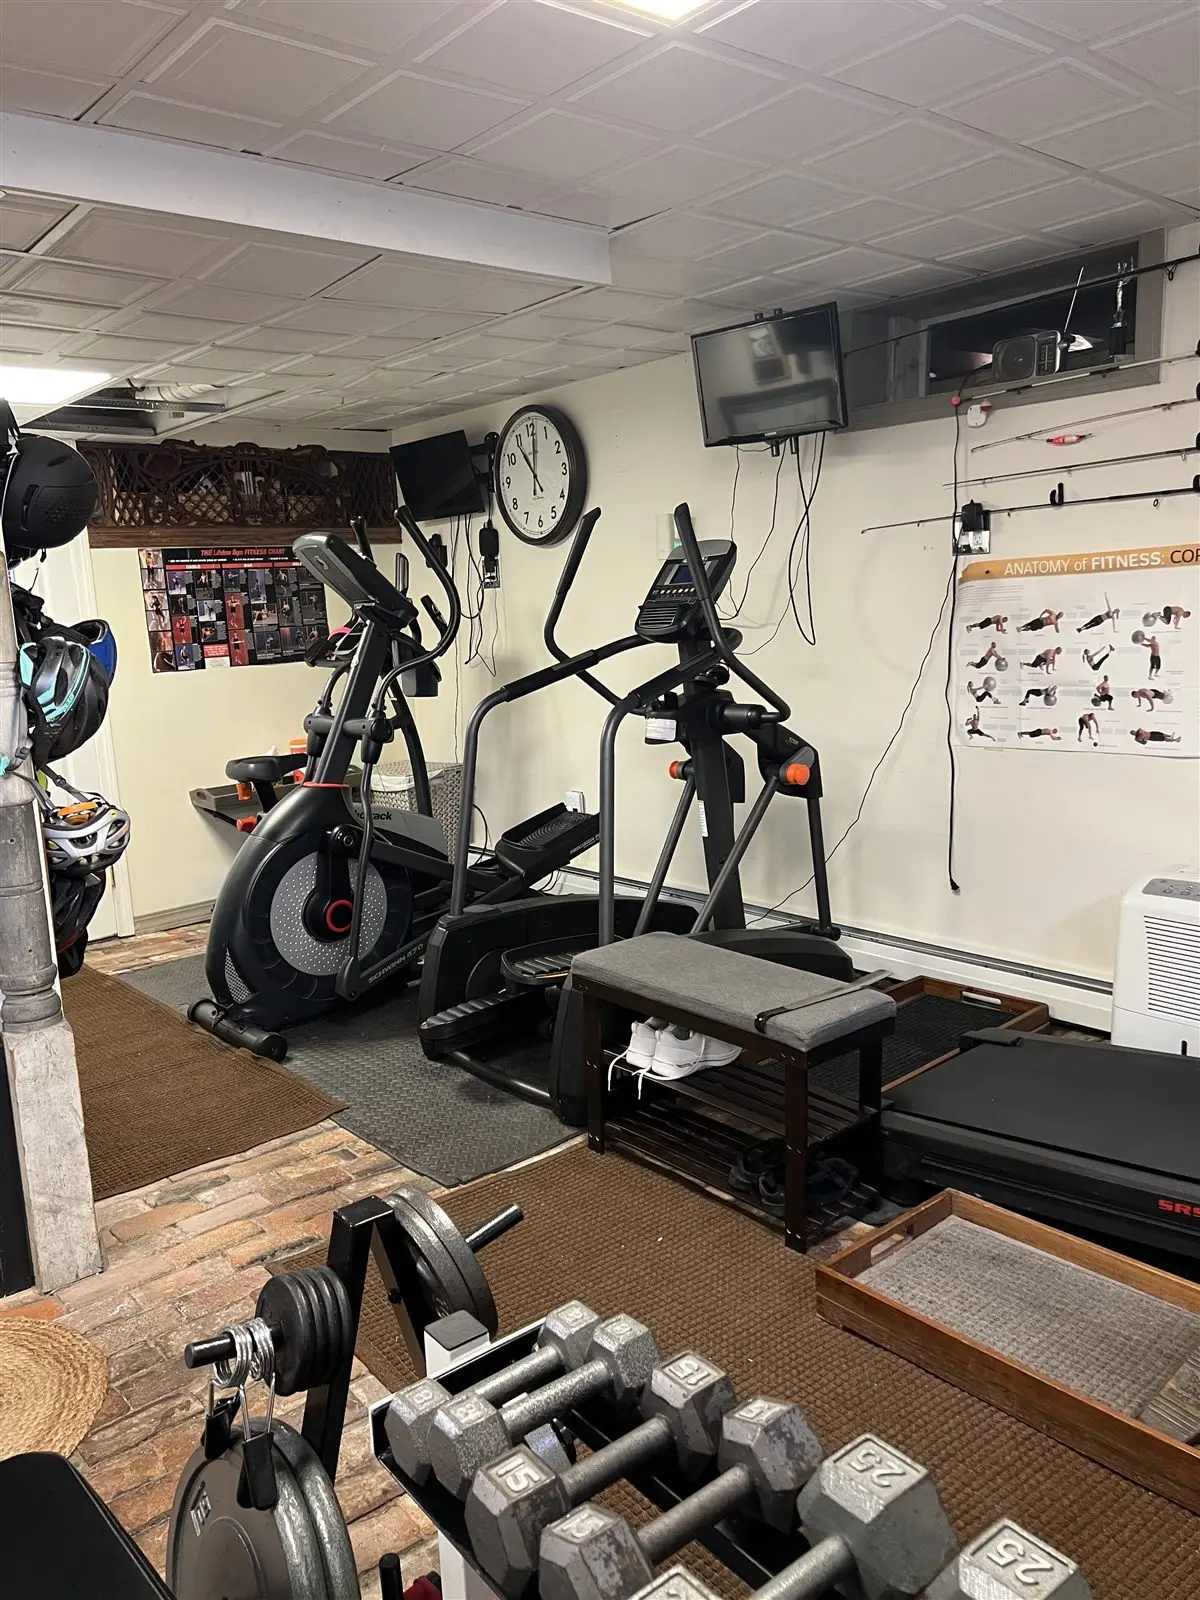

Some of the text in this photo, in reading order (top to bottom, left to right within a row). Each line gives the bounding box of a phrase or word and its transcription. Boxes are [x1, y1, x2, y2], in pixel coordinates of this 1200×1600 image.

[526, 422, 536, 437] 12
[515, 434, 522, 447] 11
[554, 440, 561, 454] 2
[507, 453, 516, 466] 10
[561, 462, 568, 476] 3
[505, 476, 511, 489] 9
[559, 488, 565, 500] 4
[512, 498, 519, 510] 8
[523, 512, 530, 524] 7
[550, 506, 557, 519] 5
[537, 515, 544, 528] 6
[244, 548, 267, 556] FITNESS
[1004, 559, 1071, 576] ANATOMY
[1073, 557, 1089, 571] of
[1090, 551, 1165, 570] FITNESS:
[367, 943, 424, 984] SCHWINN 470
[668, 1359, 711, 1385] 15
[496, 1457, 541, 1493] 15
[849, 1449, 906, 1487] 25
[561, 1512, 605, 1539] 15
[987, 1539, 1054, 1586] 25
